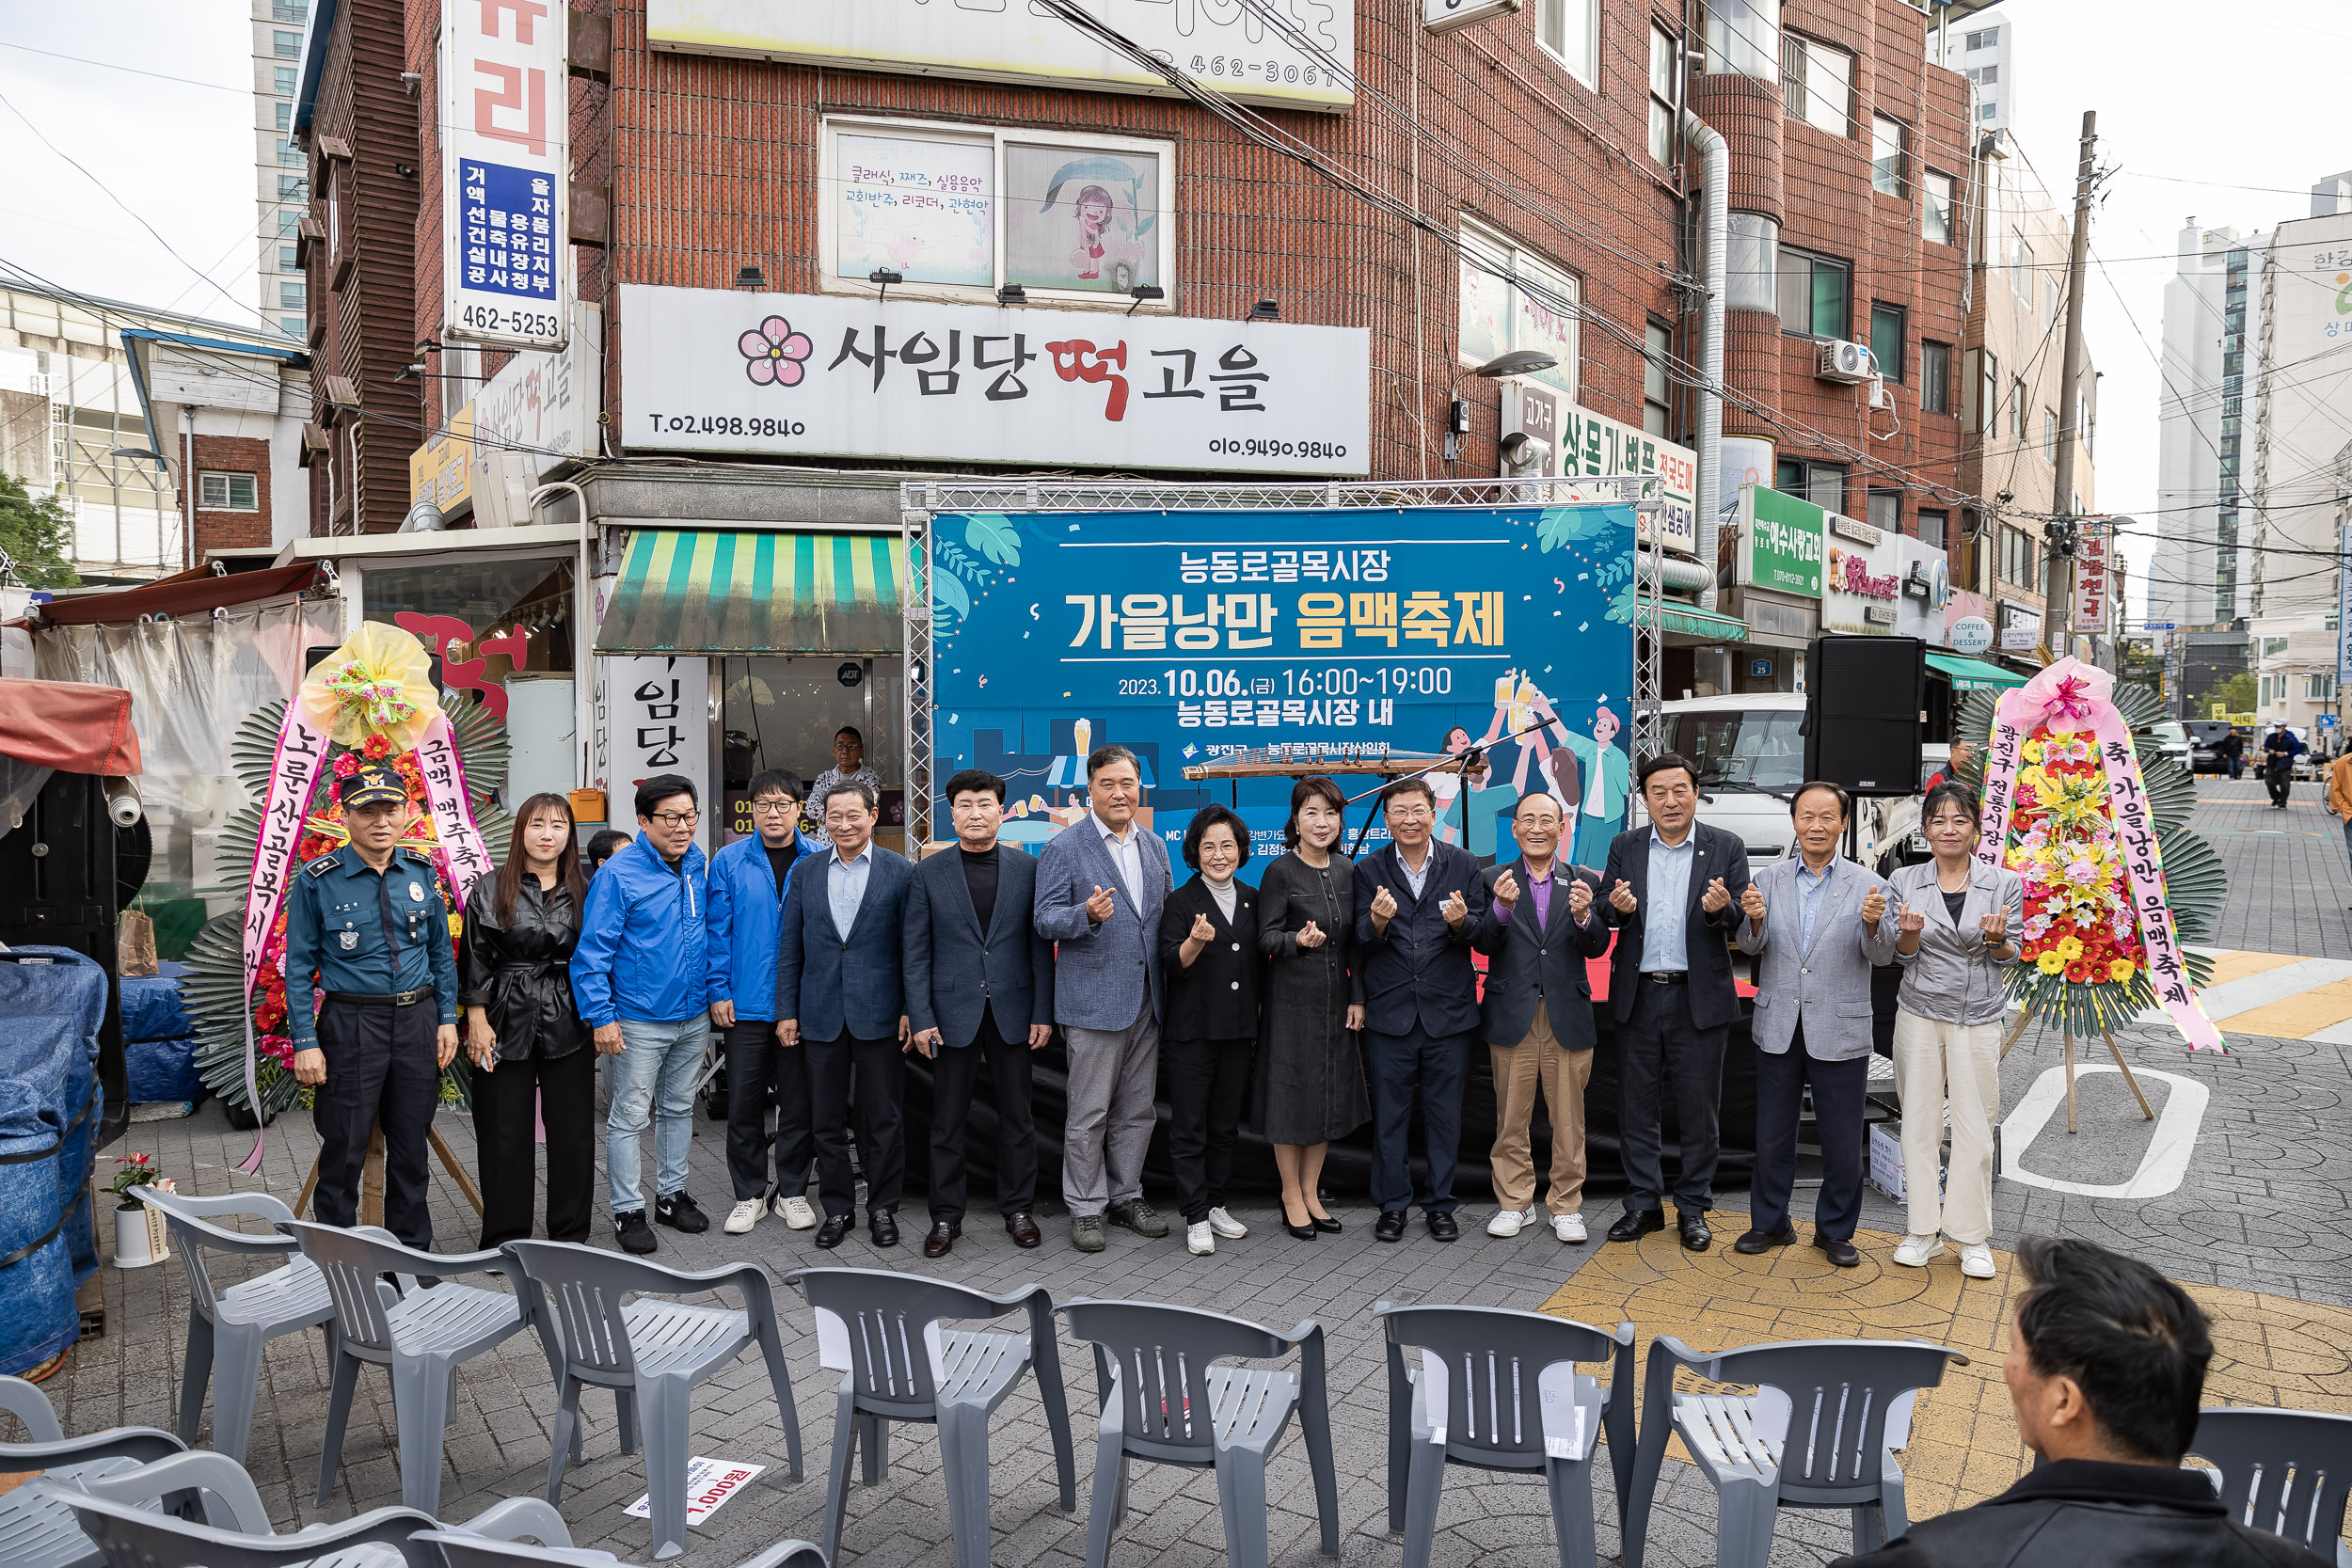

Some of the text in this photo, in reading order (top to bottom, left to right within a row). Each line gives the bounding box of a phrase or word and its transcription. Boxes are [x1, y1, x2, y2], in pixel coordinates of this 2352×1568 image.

[1190, 55, 1335, 87] 462-3067
[852, 165, 895, 185] 클래식,
[937, 174, 982, 193] 실용음악
[846, 189, 989, 216] 교회반주, 리코더, 관현악
[467, 226, 550, 255] 건축유리
[468, 246, 550, 274] 실내장치
[468, 266, 550, 293] 공사청부
[463, 305, 558, 338] 462-5253
[1526, 396, 1552, 432] 고가구
[1208, 438, 1347, 460] 010.9490.9840
[1660, 453, 1692, 494] 전국도매
[1770, 521, 1821, 564] 예수사랑교회
[1180, 551, 1391, 583] 능동로골목시장
[1065, 591, 1505, 650] 가을낭만 음맥축제
[1955, 623, 1985, 631] COFFEE
[841, 670, 859, 679] ADT
[1118, 678, 1162, 696] 2023.
[1282, 667, 1452, 696] 16:00~19:00
[632, 657, 686, 768] 임당
[1177, 697, 1394, 728] 능동로골목시장 내
[1205, 744, 1248, 756] 광진구
[1991, 724, 2021, 773] 광진구
[1980, 779, 2009, 847] 전통시장
[1166, 830, 1182, 842] MC
[2106, 742, 2190, 1007] 축 가을낭만 음맥축제
